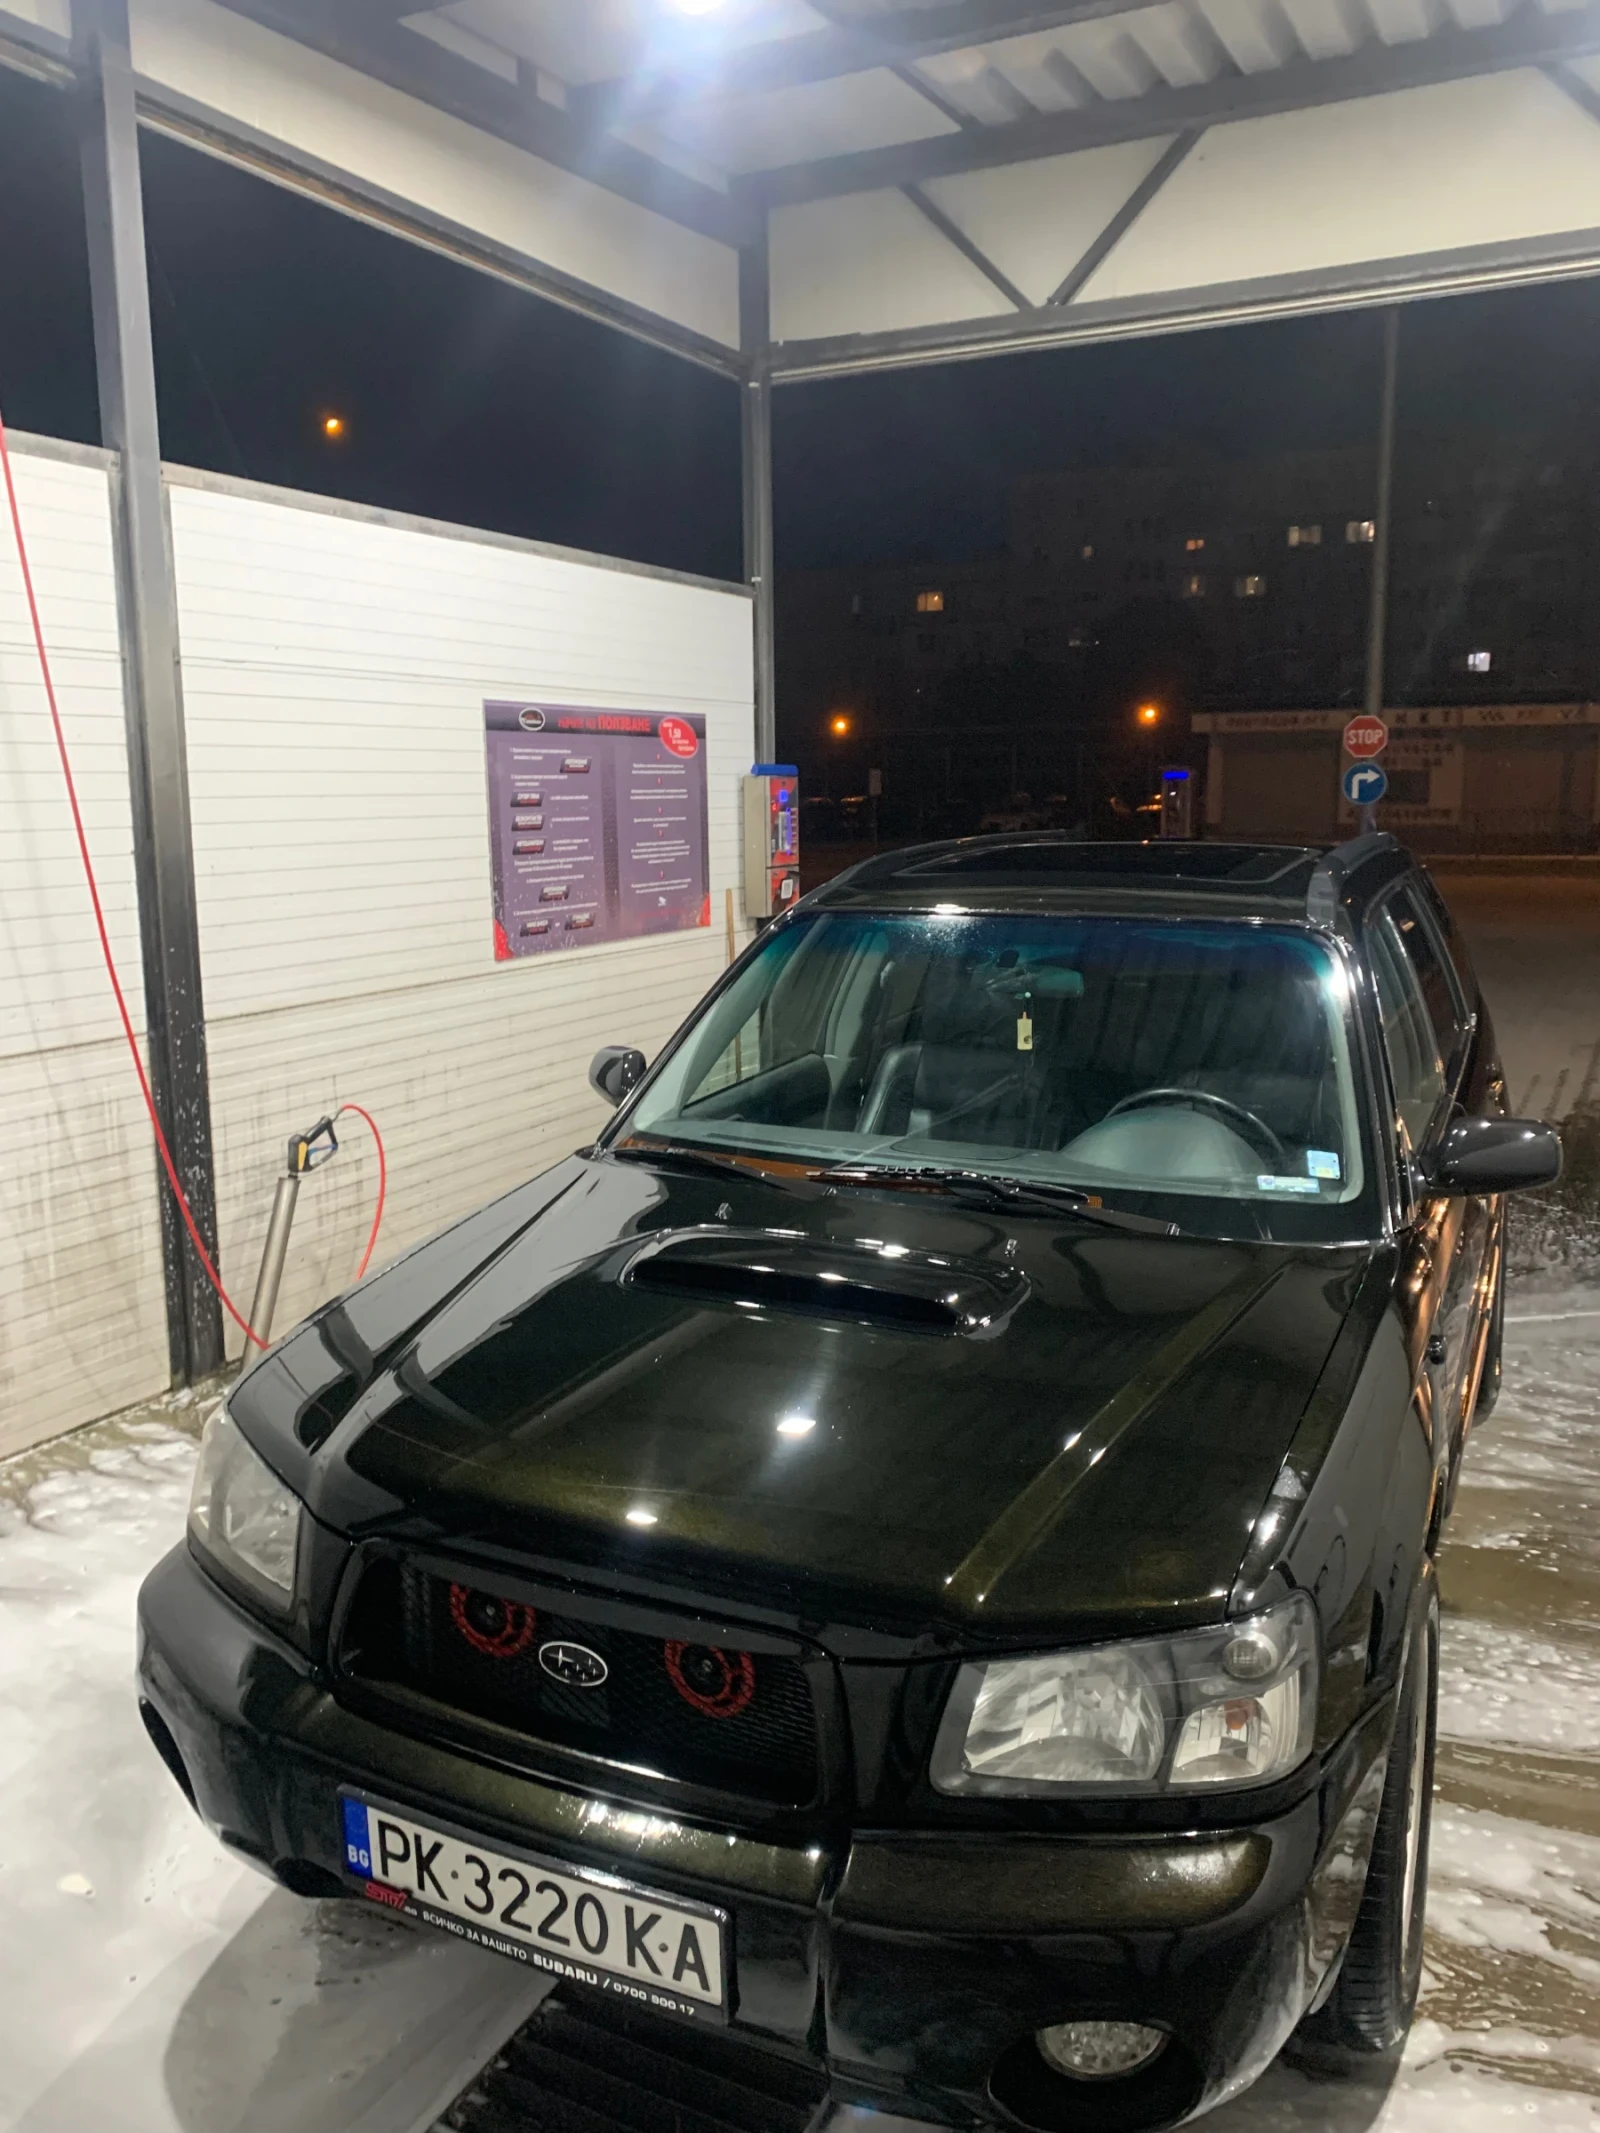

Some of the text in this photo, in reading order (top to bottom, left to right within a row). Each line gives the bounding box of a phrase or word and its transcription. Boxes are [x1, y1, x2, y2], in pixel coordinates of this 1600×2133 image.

[1348, 729, 1383, 744] STOP
[346, 1844, 369, 1868] BG
[464, 1854, 609, 1955] 3220
[422, 1911, 464, 1935] ВСИЧКО
[467, 1928, 480, 1942] ЗА
[482, 1934, 527, 1961] ВАШЕТО
[533, 1953, 598, 1985] SUBARU
[613, 1981, 647, 2001] 0700
[650, 1994, 676, 2012] 900
[679, 2004, 695, 2016] 17
